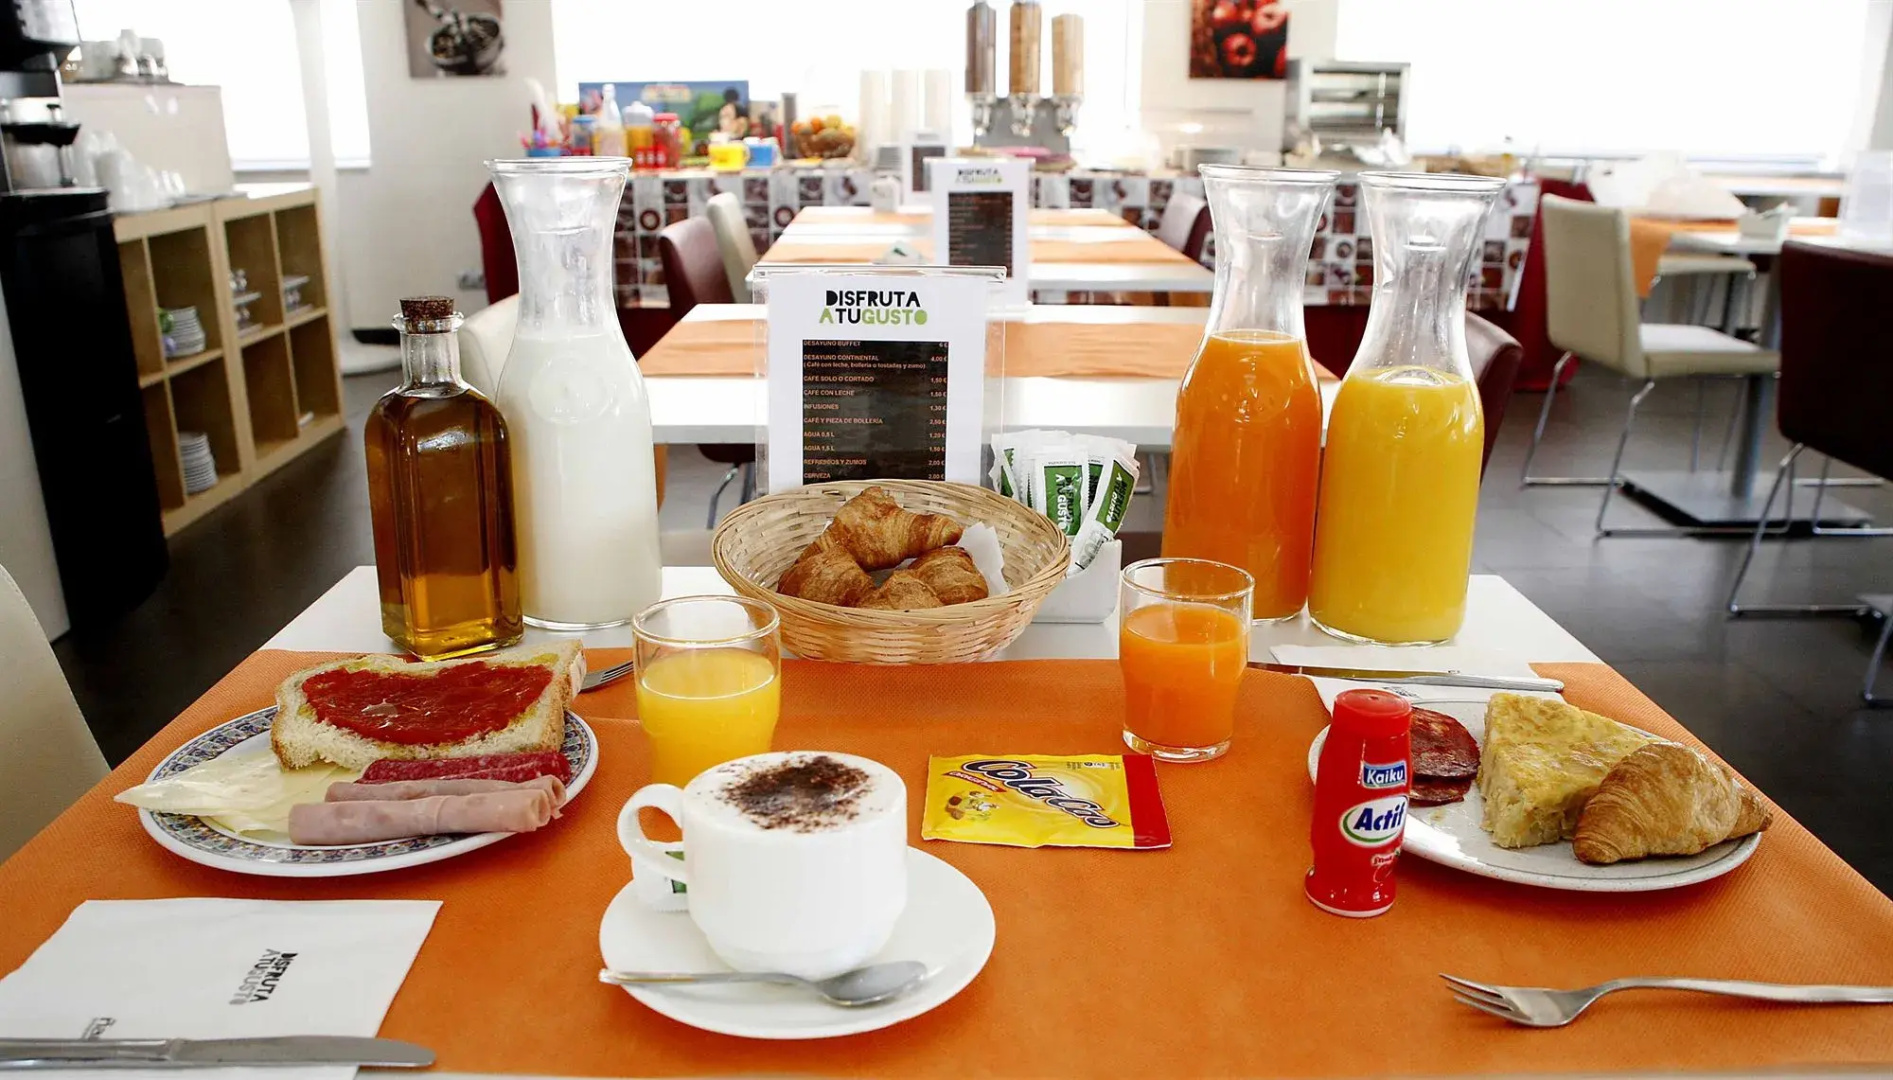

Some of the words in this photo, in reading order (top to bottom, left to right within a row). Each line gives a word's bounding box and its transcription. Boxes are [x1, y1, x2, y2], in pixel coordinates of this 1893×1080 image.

[826, 290, 921, 307] DISFRUTA
[1366, 768, 1404, 788] Kaiku
[1353, 801, 1406, 831] Actif
[249, 953, 298, 1003] DISFRUTA
